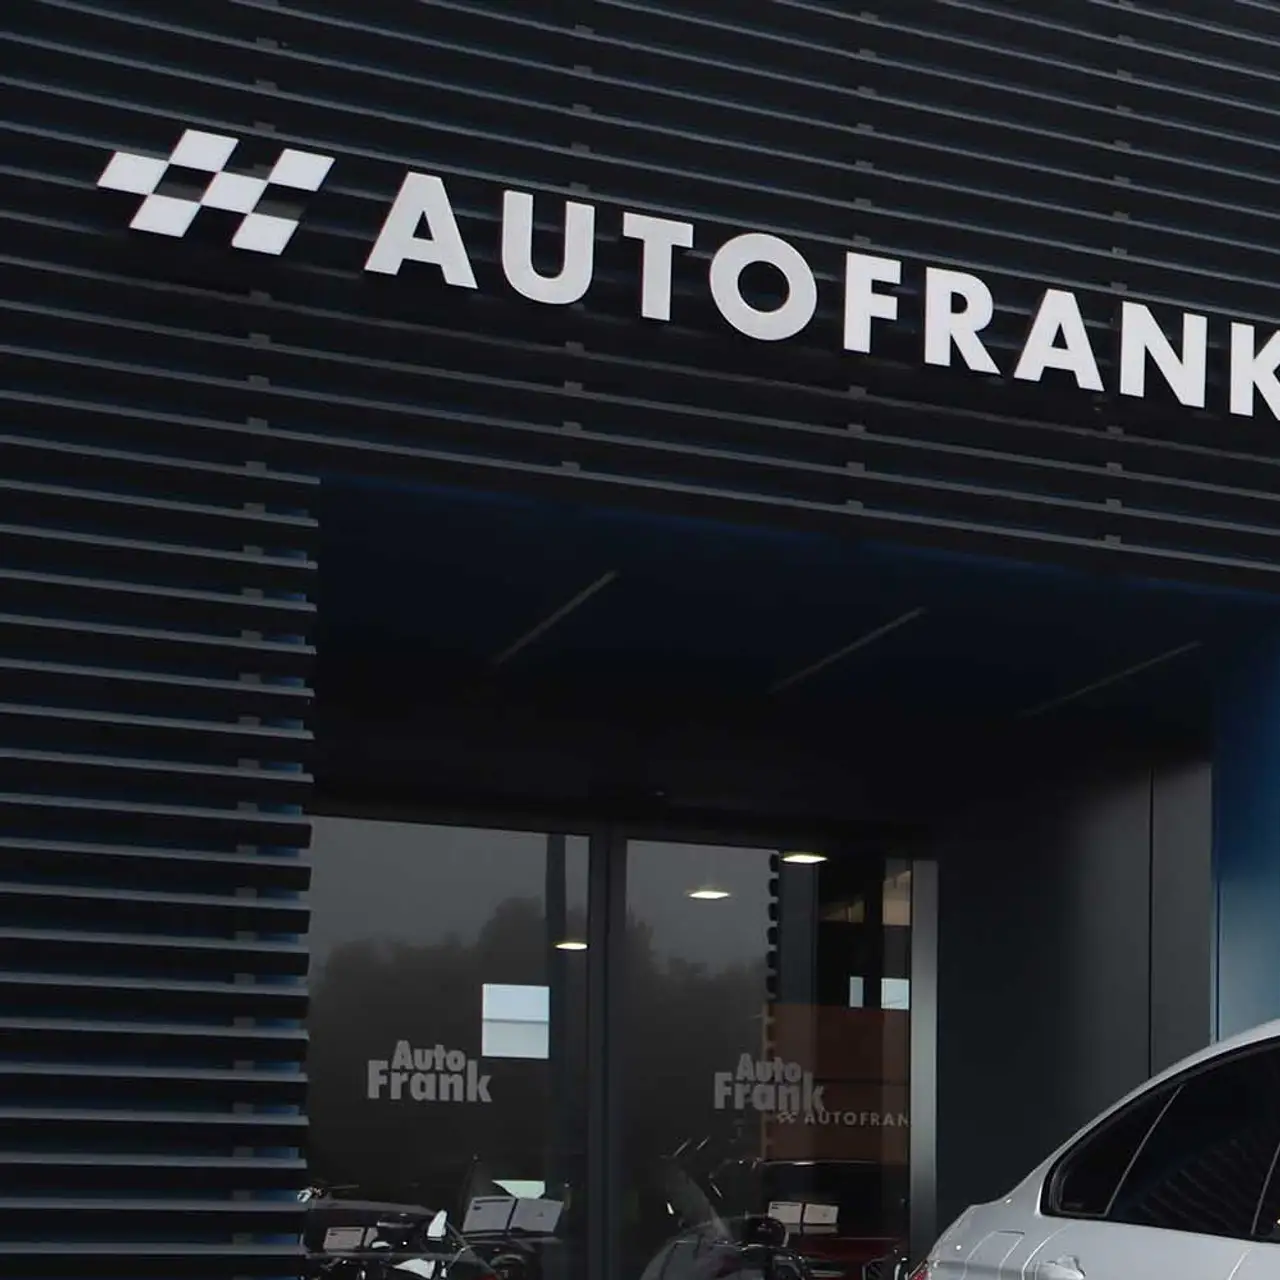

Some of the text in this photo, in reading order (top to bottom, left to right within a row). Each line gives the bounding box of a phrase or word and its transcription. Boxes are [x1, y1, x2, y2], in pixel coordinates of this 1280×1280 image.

[391, 1040, 466, 1072] Auto
[736, 1053, 801, 1082] Auto
[368, 1060, 493, 1102] Frank
[714, 1072, 824, 1112] Frank
[803, 1111, 912, 1128] AUTOFRAN
